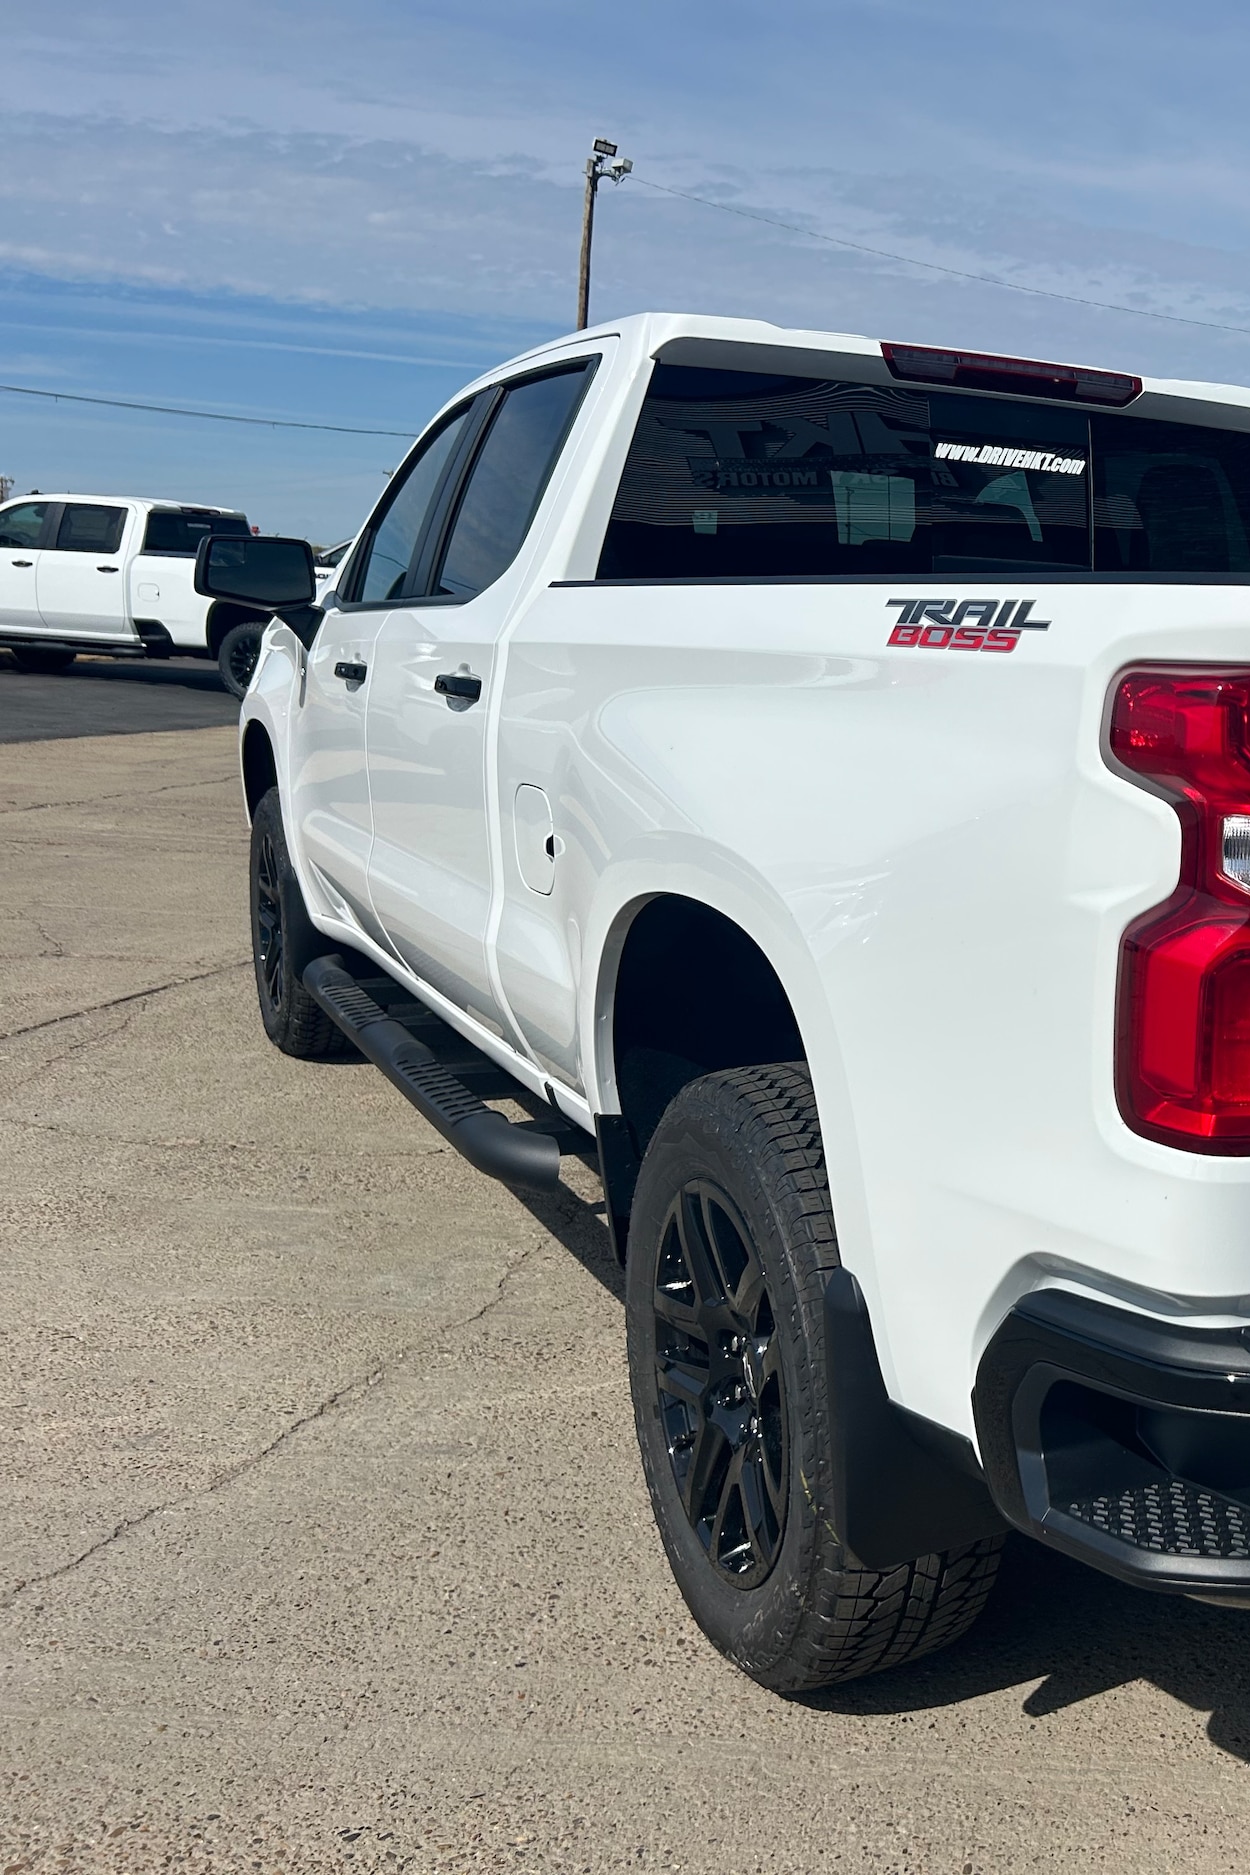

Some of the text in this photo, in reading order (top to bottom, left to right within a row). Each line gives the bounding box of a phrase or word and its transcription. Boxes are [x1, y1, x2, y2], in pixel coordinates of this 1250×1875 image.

[934, 442, 1086, 475] www.DRIVEHKT.com
[885, 598, 1052, 631] TRAIL
[886, 624, 1023, 654] BOSS
